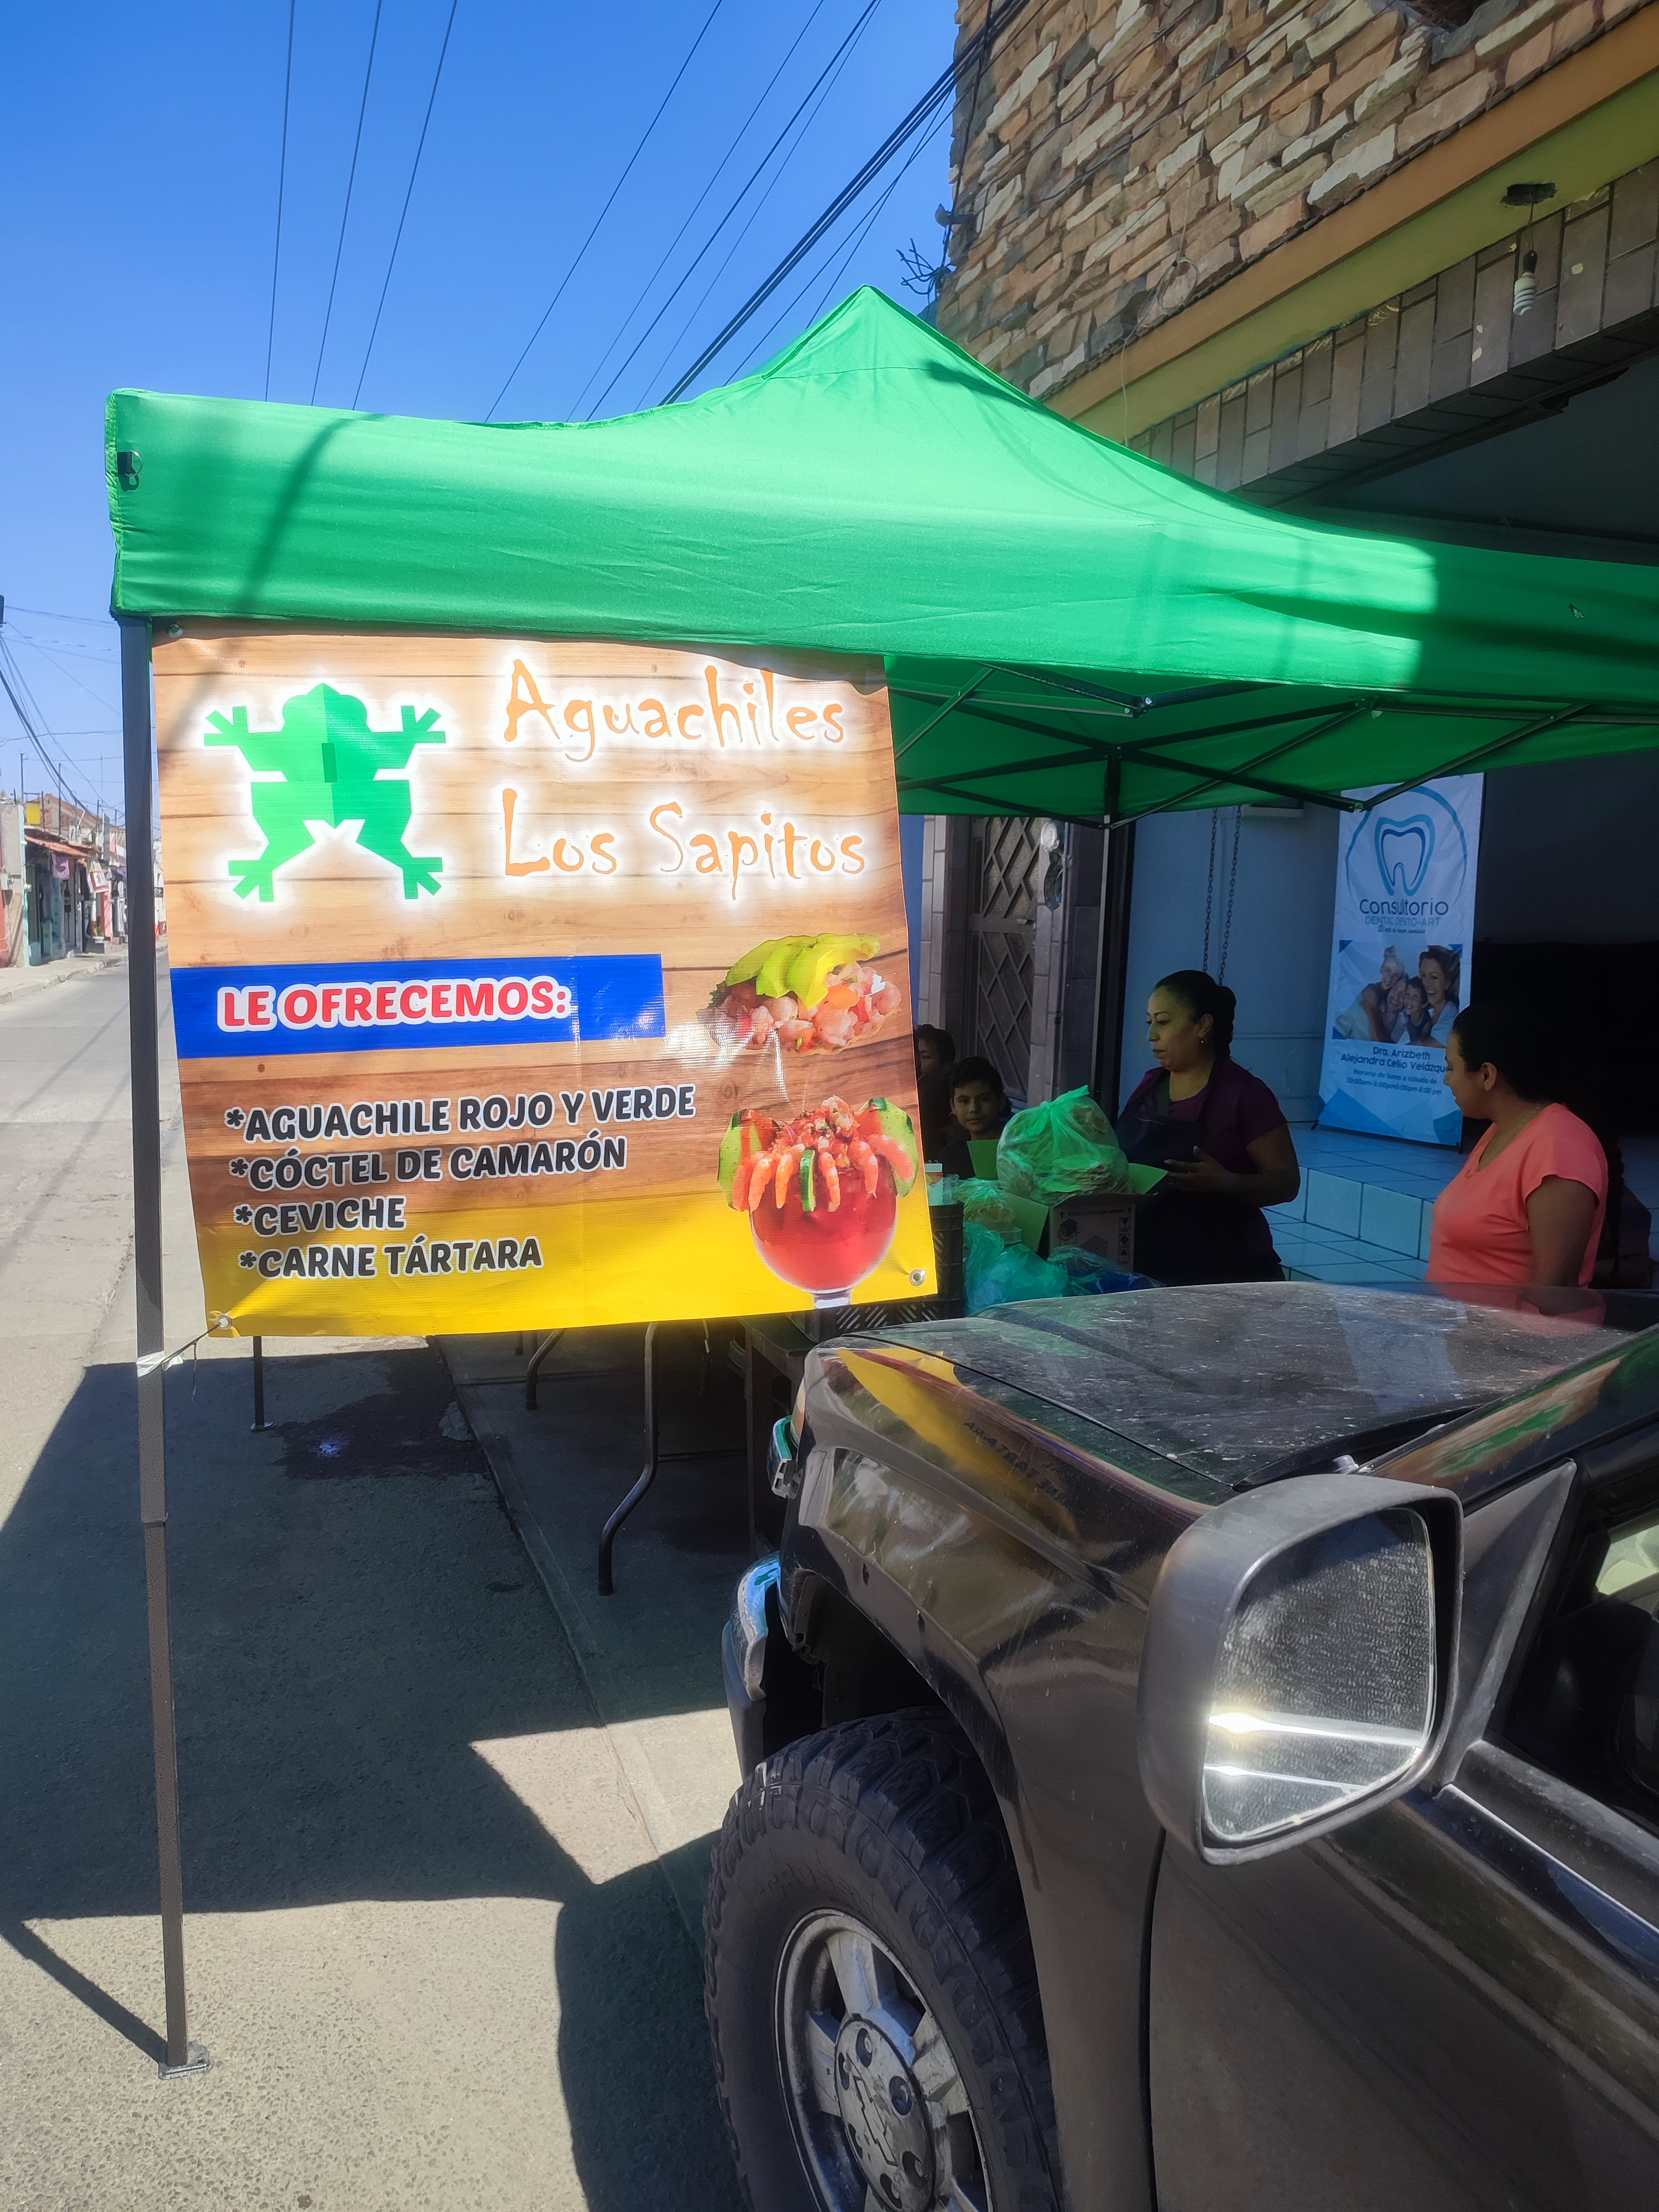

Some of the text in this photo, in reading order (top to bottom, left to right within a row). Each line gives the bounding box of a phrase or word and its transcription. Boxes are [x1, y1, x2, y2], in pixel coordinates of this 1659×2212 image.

[504, 659, 844, 762] Aguachiles
[502, 788, 865, 901] Los Sapitos
[1359, 898, 1449, 916] Consultorio
[222, 979, 568, 1028] LE OFRECEMOS:
[1340, 1053, 1385, 1066] Alejandra
[1386, 1058, 1407, 1069] Celio
[1391, 1048, 1431, 1061] Arizbeth
[459, 1093, 552, 1129] ROJO
[561, 1092, 584, 1124] Y
[591, 1084, 695, 1122] VERDE
[398, 1147, 441, 1181] DE
[451, 1132, 626, 1180] CAMARÓN
[385, 1235, 542, 1275] TÁRTARA
